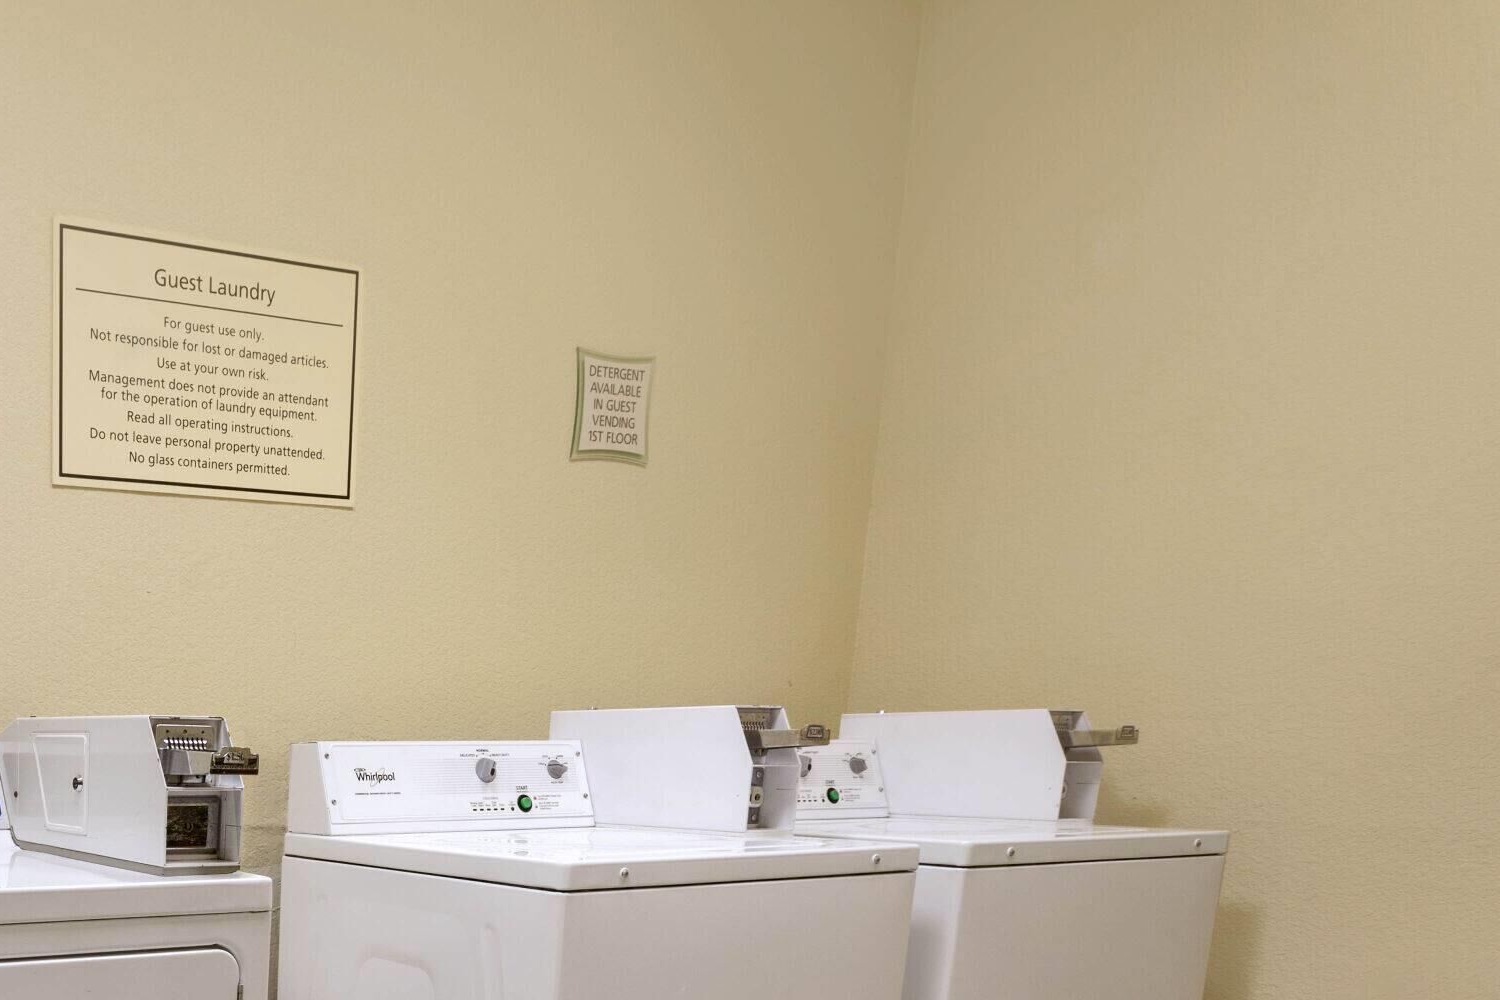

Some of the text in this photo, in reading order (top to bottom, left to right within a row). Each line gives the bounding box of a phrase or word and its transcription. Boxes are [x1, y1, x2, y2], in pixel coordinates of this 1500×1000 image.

[154, 269, 276, 307] Guest Laundry
[164, 316, 265, 343] For guest use only.
[90, 328, 329, 369] Not responsible for lost or damaged articles.
[157, 357, 269, 381] Use at your own risk.
[589, 364, 646, 381] DETERGENT
[89, 369, 329, 407] Management does not provide an attendant
[590, 382, 642, 398] AVAILABLE
[101, 387, 317, 422] for the operation of laundry equipment.
[594, 398, 637, 413] IN GUEST
[127, 411, 293, 438] Read all operating instructions.
[592, 414, 636, 429] VENDING
[90, 428, 325, 460] Do not leave personal property unattended.
[589, 430, 638, 446] 1ST FLOOR
[129, 451, 290, 476] No glass containers permitted.
[355, 771, 396, 783] Whirlpool
